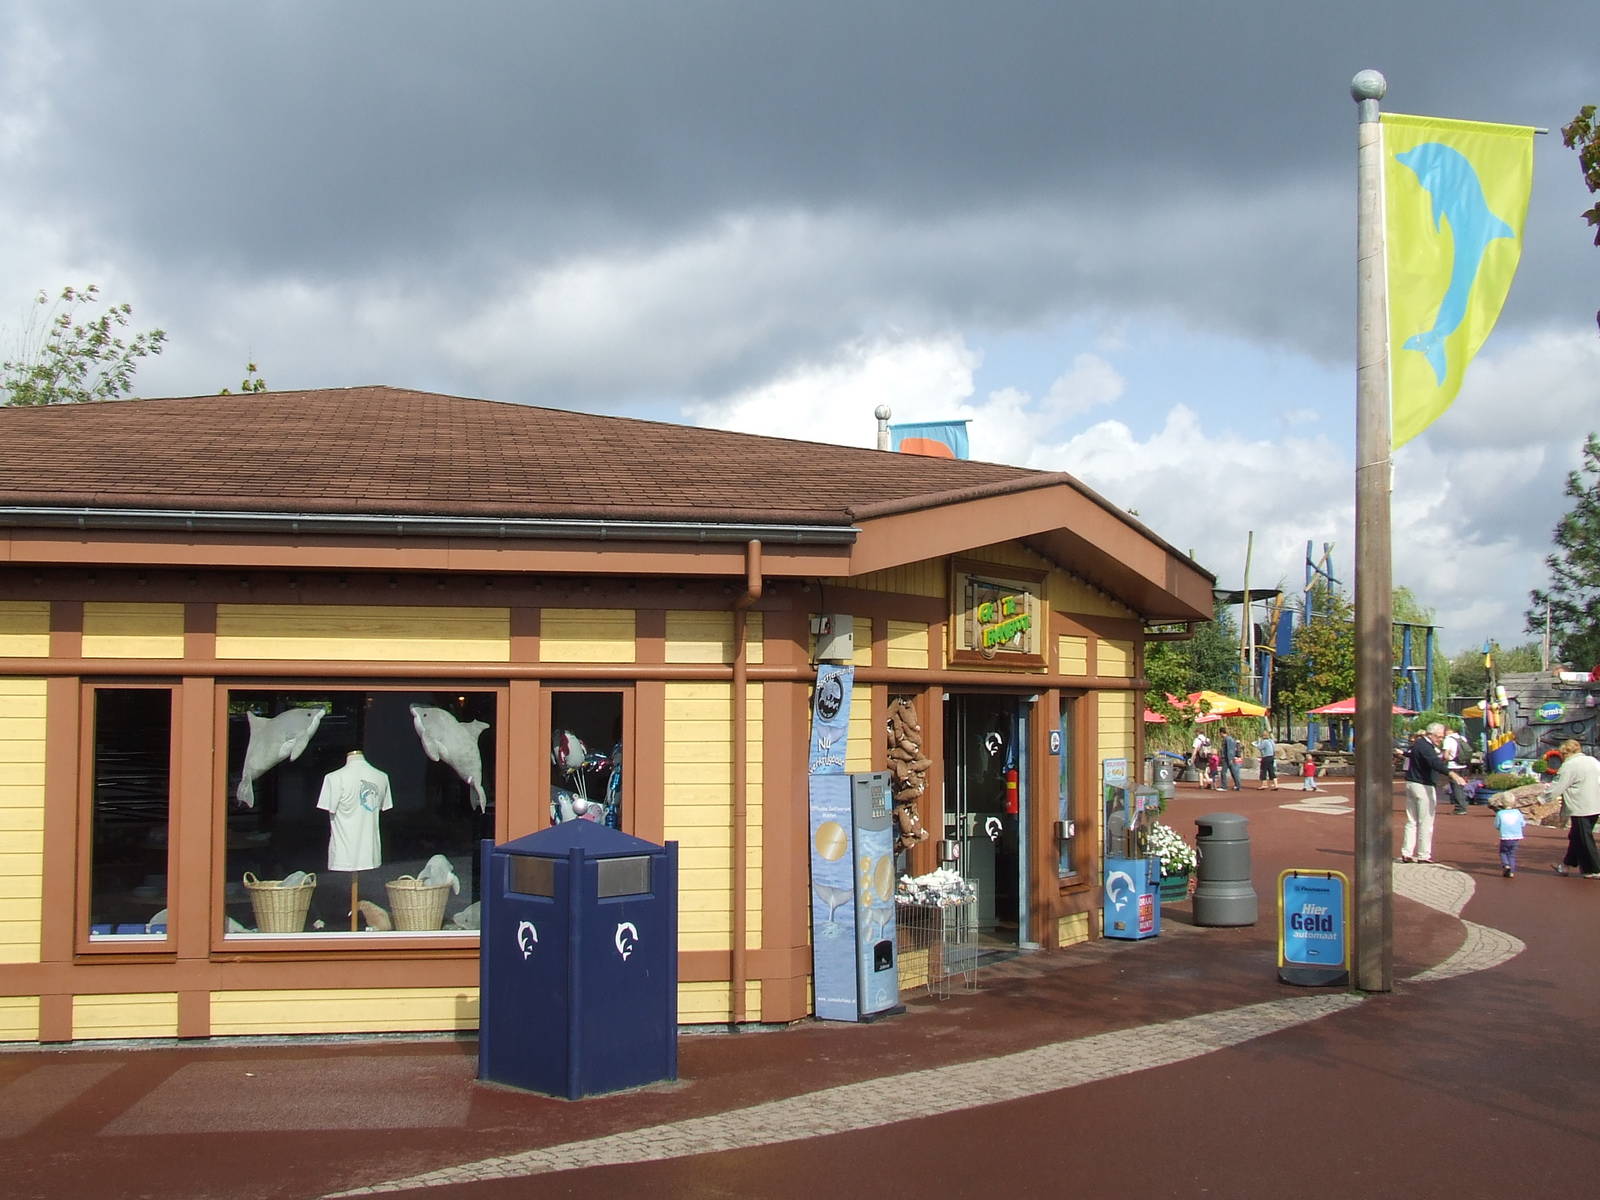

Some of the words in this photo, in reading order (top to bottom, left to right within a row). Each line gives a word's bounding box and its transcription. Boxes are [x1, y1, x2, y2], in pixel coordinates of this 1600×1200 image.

[1302, 904, 1328, 915] Hier
[1291, 912, 1332, 932] Geld
[1293, 931, 1336, 940] automaat
